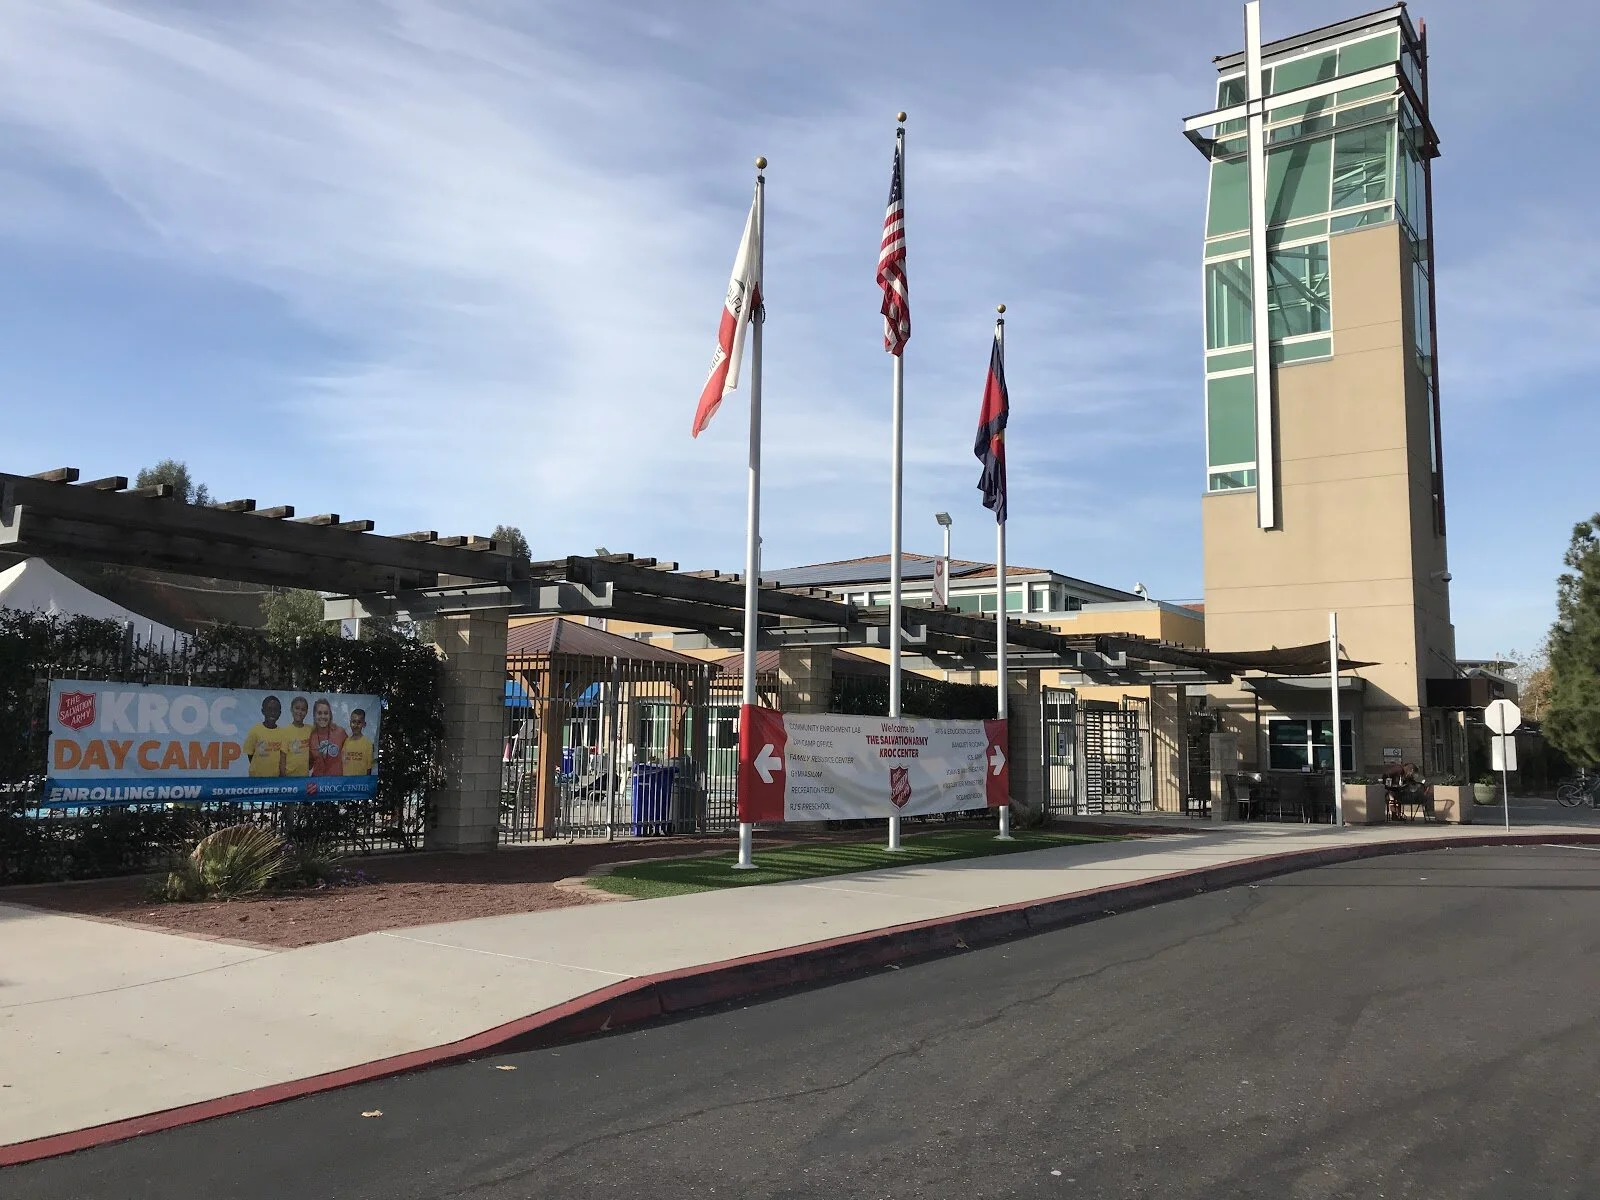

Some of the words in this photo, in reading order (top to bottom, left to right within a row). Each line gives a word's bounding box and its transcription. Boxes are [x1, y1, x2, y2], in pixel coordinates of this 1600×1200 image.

[66, 695, 80, 707] THE
[60, 697, 93, 720] SALVATION
[100, 691, 238, 735] KROC
[71, 708, 91, 726] ARMY
[789, 722, 820, 732] COMMUNITY
[820, 724, 851, 734] ENRICHMENT
[851, 726, 862, 734] LAB
[881, 722, 909, 734] Welcome
[865, 735, 880, 745] THE
[879, 735, 913, 746] SALVATION
[912, 736, 929, 747] ARMY
[54, 739, 135, 770] DAY
[137, 740, 242, 770] CAMP
[789, 753, 811, 763] FAMILY
[834, 756, 855, 765] CENTER
[879, 747, 897, 758] KROC
[896, 748, 919, 759] CENTER
[49, 787, 155, 801] ENROLLING
[157, 785, 202, 799] NOW
[211, 786, 299, 796] SD.KROCCENTER.ORG
[319, 784, 342, 793] KROC
[342, 783, 370, 792] CENTER
[791, 786, 820, 794] RECREATION
[801, 802, 831, 811] PRESCHOOL
